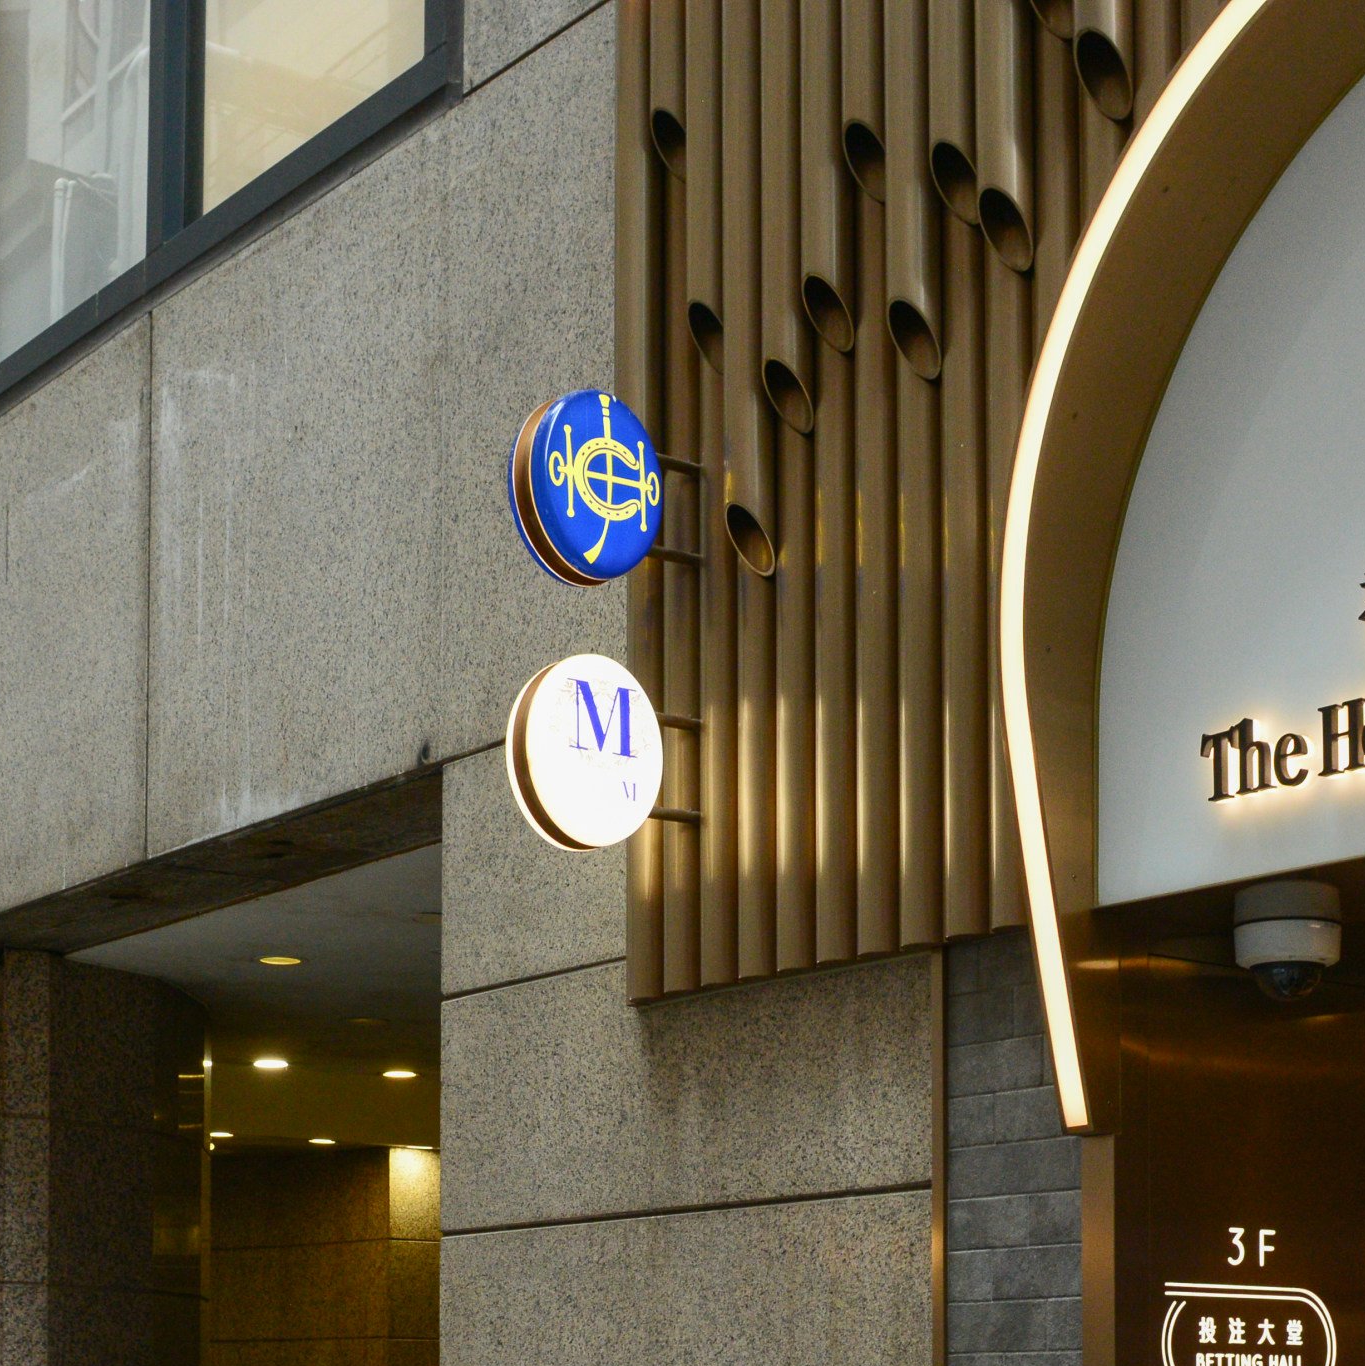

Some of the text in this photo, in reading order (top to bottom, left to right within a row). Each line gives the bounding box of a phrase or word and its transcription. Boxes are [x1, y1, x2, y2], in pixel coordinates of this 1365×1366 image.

[567, 678, 637, 758] M
[1199, 717, 1309, 801] The
[1227, 1227, 1276, 1267] 3F
[1198, 1316, 1304, 1346] 投注大堂
